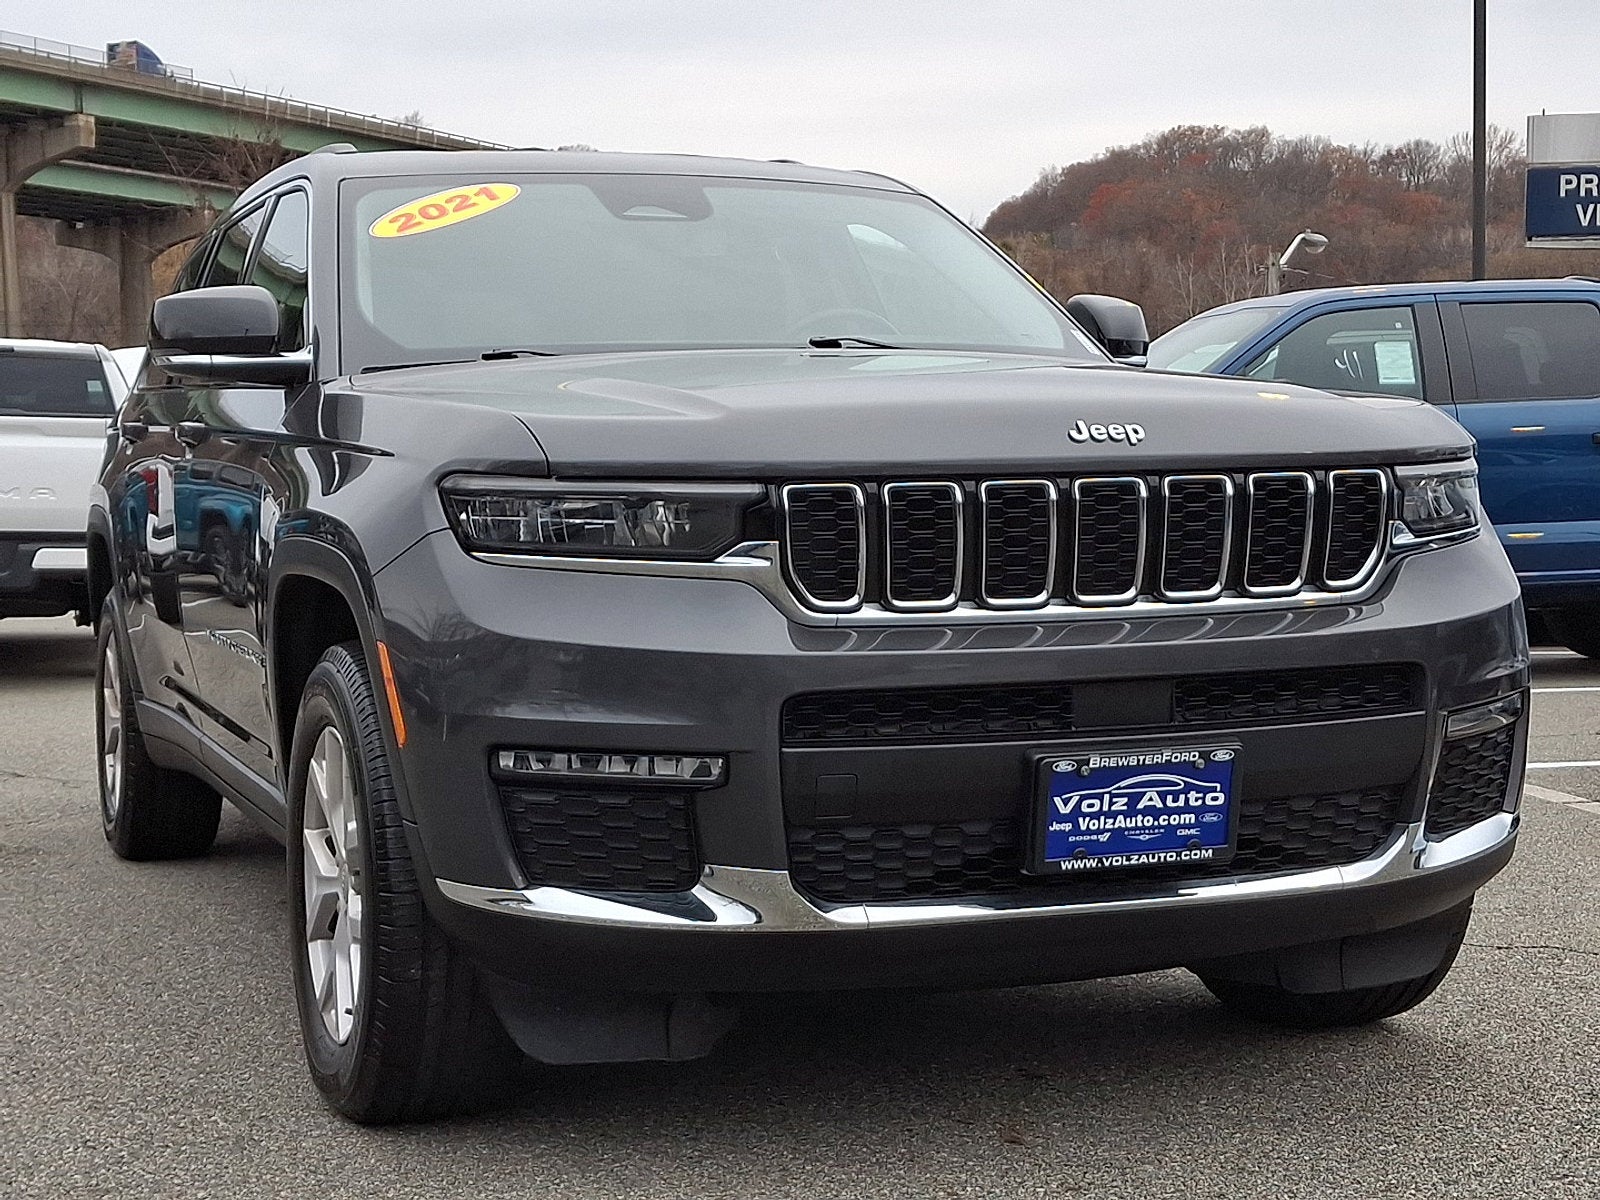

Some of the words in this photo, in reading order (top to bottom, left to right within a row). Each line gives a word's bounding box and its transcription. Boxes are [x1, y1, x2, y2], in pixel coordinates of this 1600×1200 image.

[389, 186, 500, 233] 2021
[1067, 419, 1146, 446] Jeep
[1053, 793, 1128, 814] Volz
[1136, 790, 1225, 809] Auto
[1049, 820, 1073, 833] Jeep
[1078, 812, 1195, 831] VolzAuto.com
[1176, 827, 1201, 836] GMC
[1060, 849, 1213, 870] WWW.VOLZAUTO.COM
